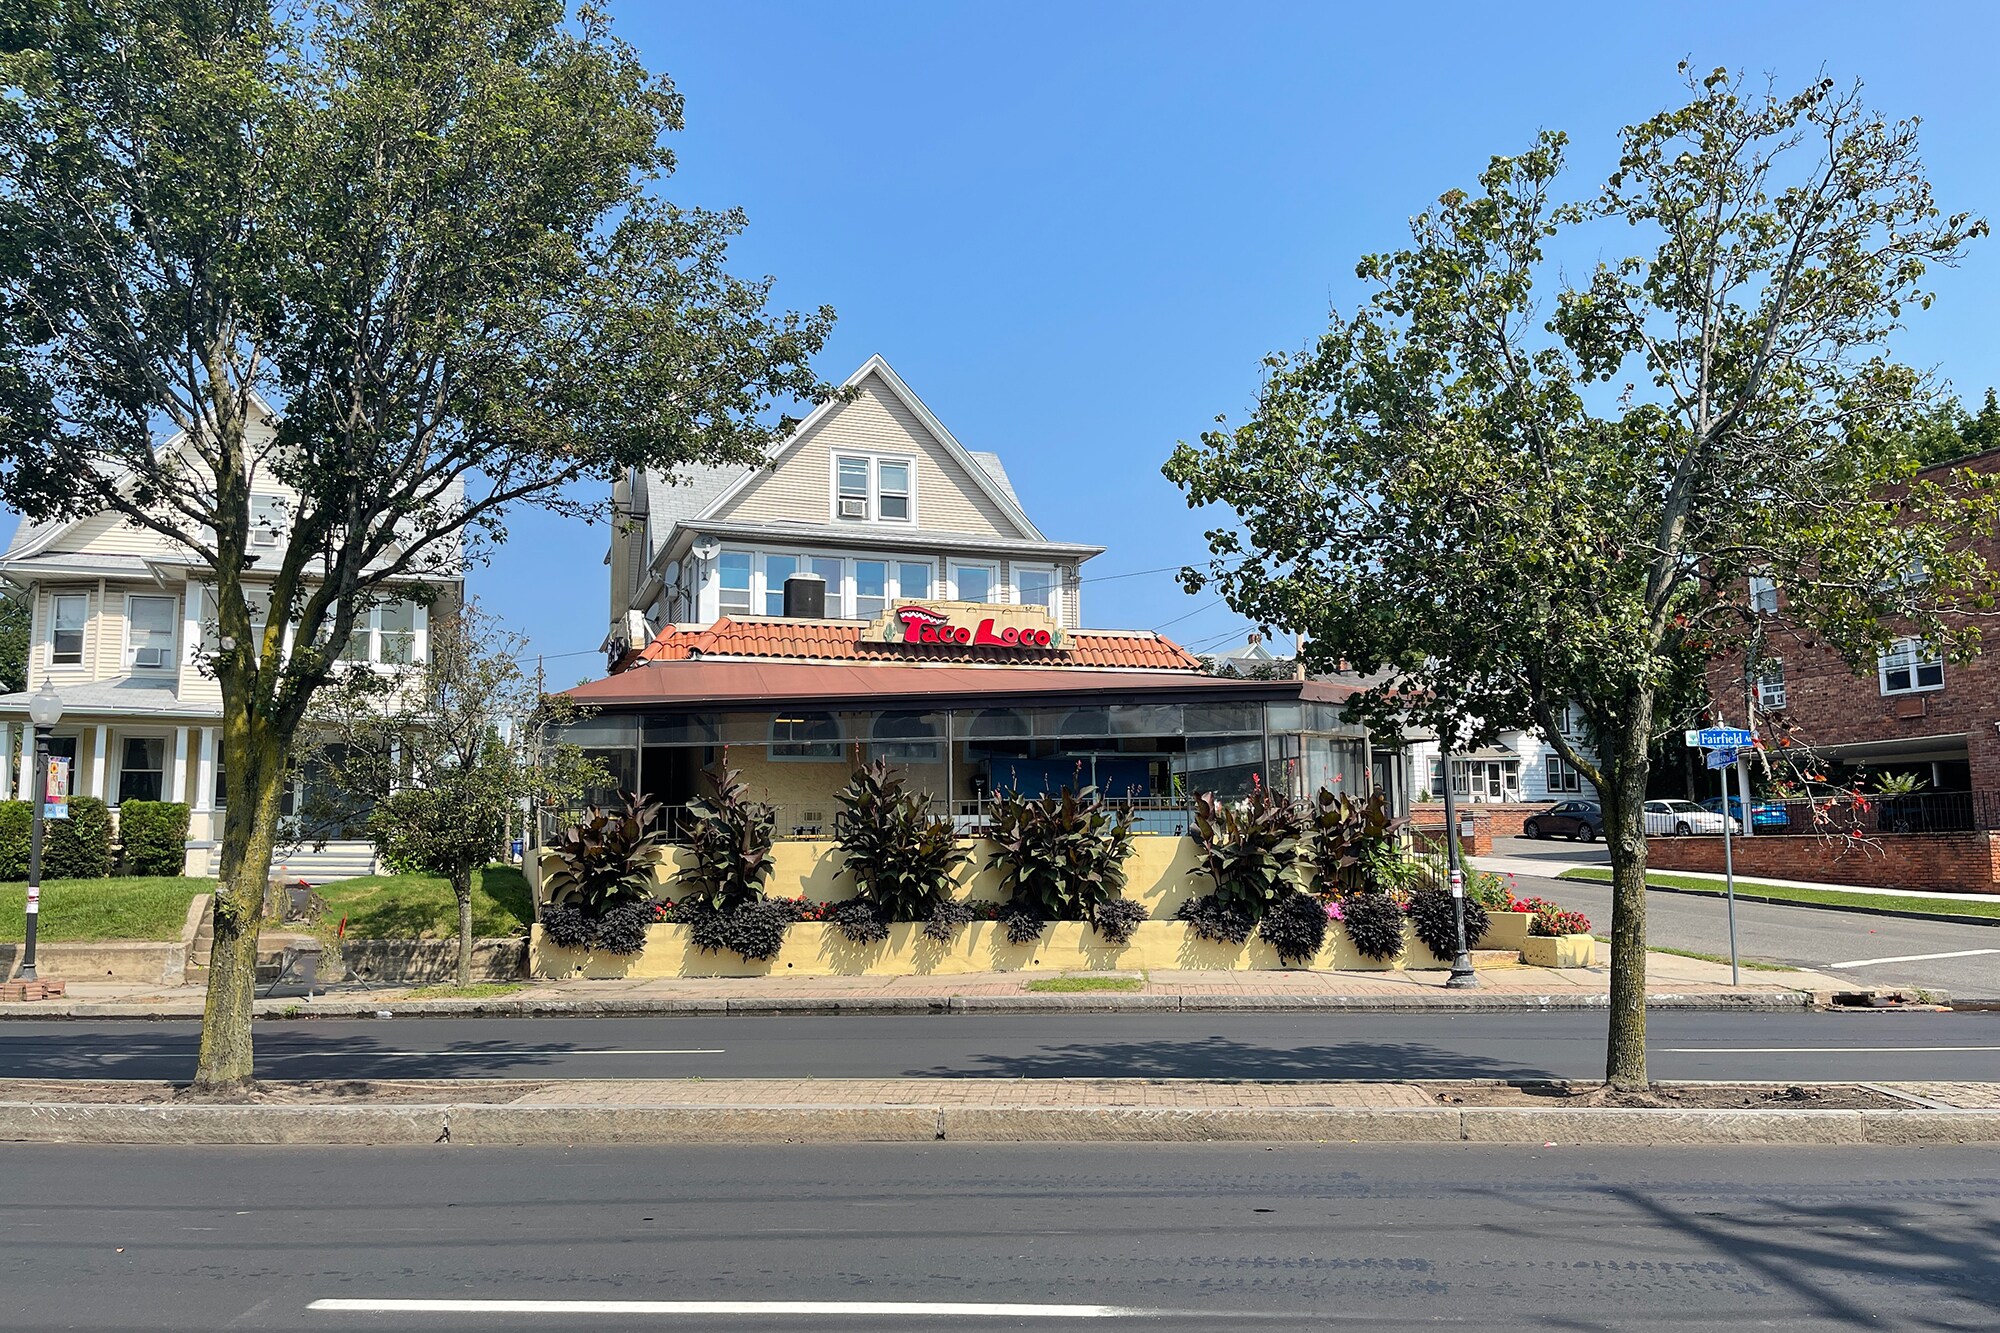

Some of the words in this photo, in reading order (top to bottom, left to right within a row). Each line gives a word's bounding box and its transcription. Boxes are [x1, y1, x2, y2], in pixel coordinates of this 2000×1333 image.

[897, 606, 970, 645] Taco
[974, 619, 1051, 647] Loco
[1701, 732, 1742, 744] Fairfield
